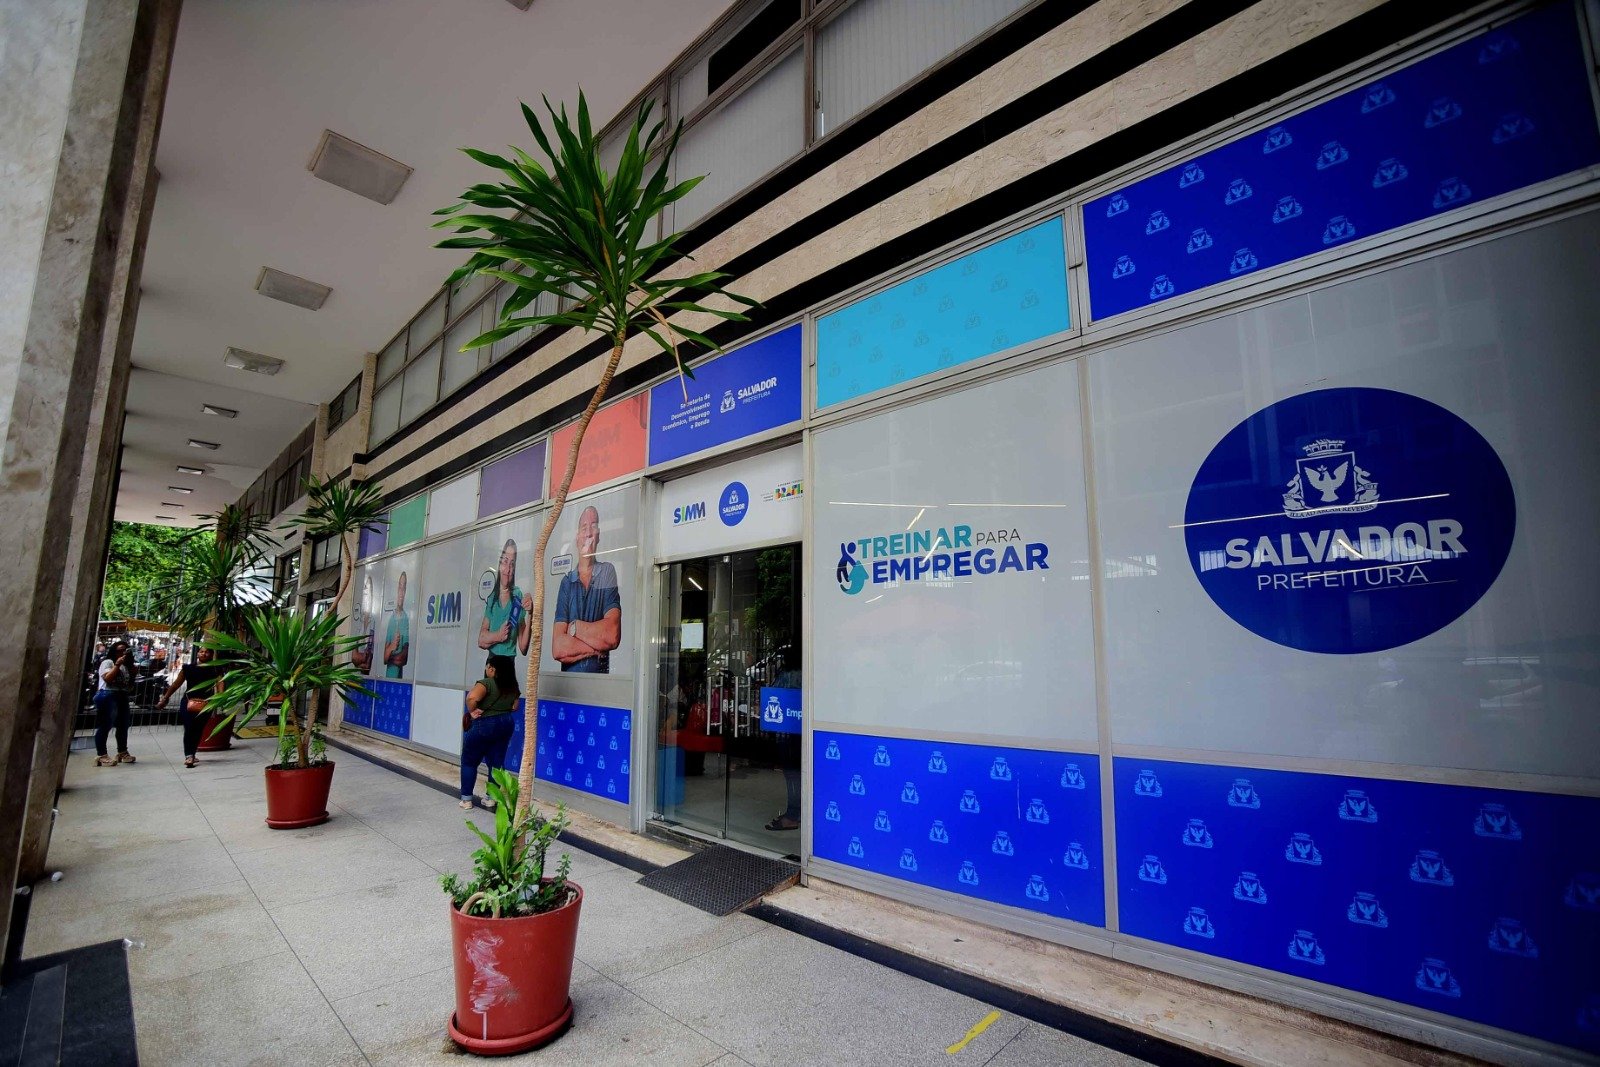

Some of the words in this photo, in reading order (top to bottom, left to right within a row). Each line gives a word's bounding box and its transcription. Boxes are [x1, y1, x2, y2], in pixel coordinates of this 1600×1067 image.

[737, 376, 777, 400] SALVADOR
[743, 390, 771, 404] PREFEITURA
[671, 402, 711, 421] Desenvolvimento
[680, 396, 703, 409] Seretaria
[688, 410, 711, 422] Emprego
[694, 417, 710, 428] Renda
[673, 501, 706, 524] SIMM
[722, 502, 745, 514] SALVADOR
[857, 525, 972, 559] TREINAR
[976, 528, 1021, 546] PARA
[1225, 518, 1468, 568] SALVADOR
[872, 542, 1049, 584] EMPREGAR
[1257, 564, 1428, 591] PREFEITURA
[427, 590, 461, 625] SIMM
